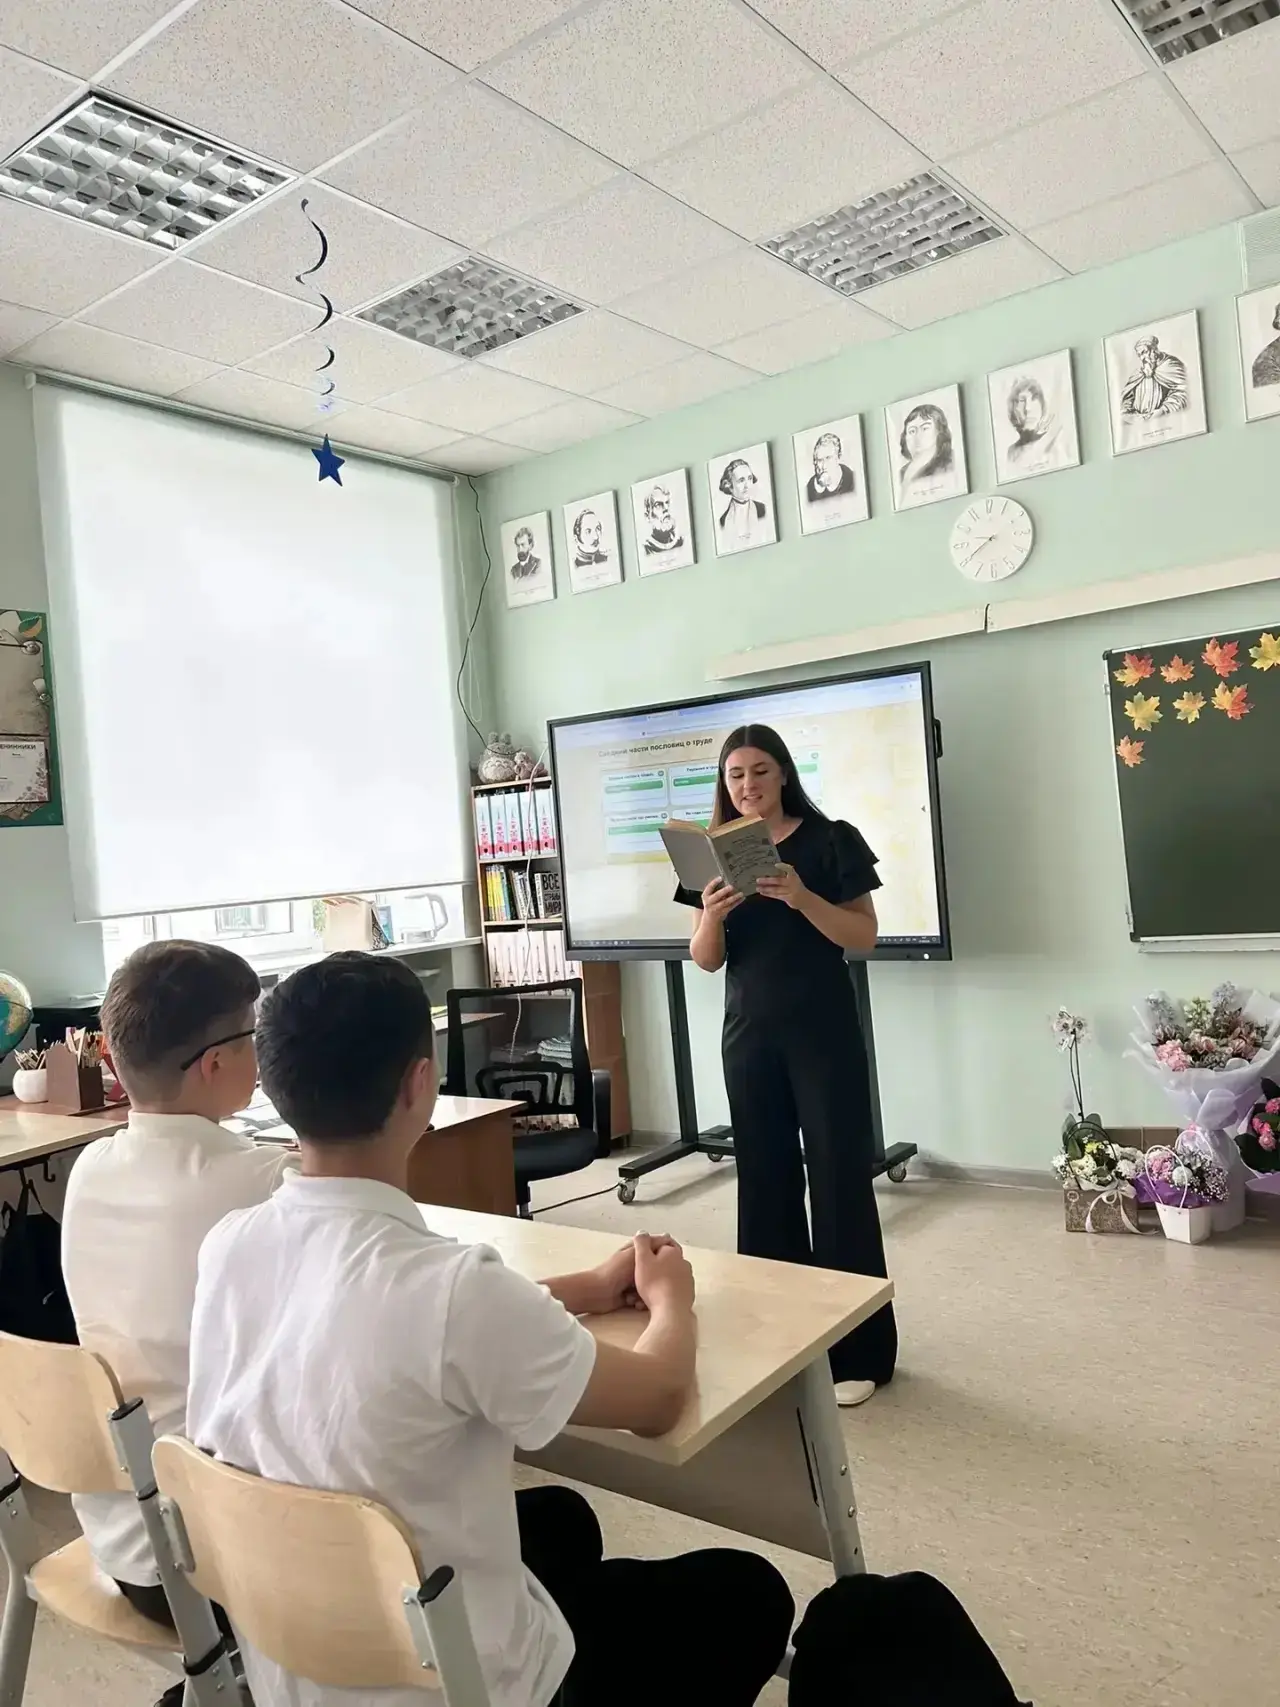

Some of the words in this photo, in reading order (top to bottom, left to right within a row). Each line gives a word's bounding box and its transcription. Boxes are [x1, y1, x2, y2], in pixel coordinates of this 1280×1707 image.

[628, 745, 649, 754] части
[649, 741, 685, 752] пословиц
[692, 737, 713, 747] труде
[542, 873, 560, 890] ВСЕ
